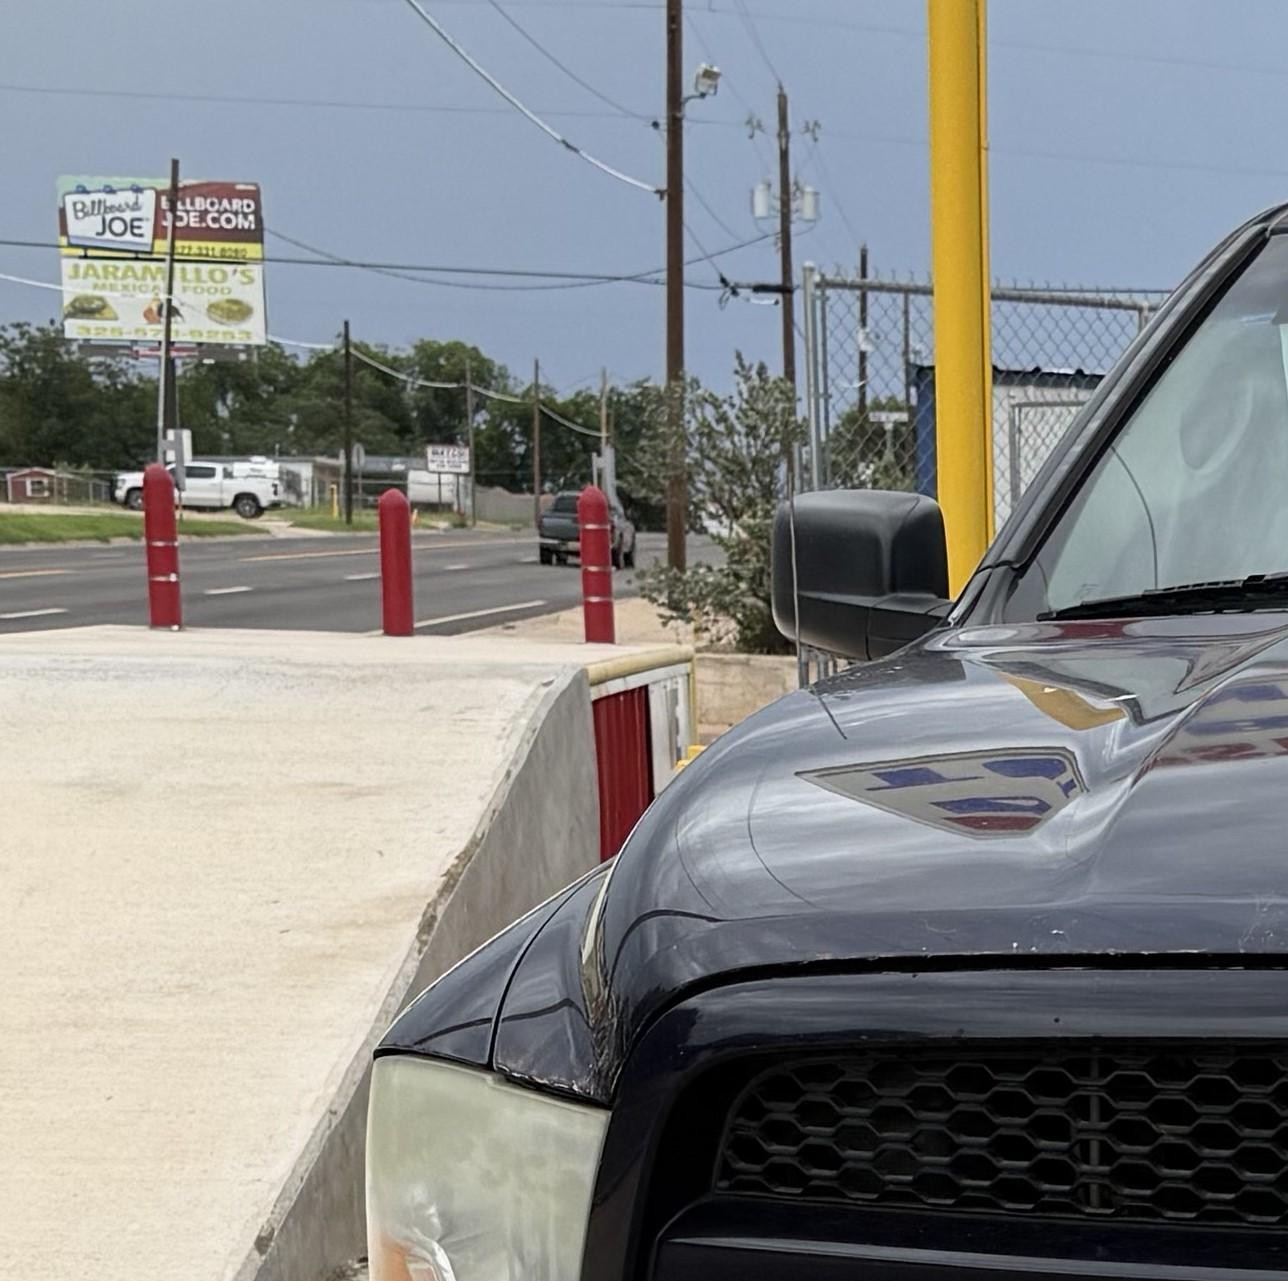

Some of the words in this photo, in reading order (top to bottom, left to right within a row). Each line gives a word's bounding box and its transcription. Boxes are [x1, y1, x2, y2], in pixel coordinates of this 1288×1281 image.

[72, 192, 142, 220] Billboard
[95, 216, 145, 238] JOE
[68, 263, 256, 285] JARAMLLO'S
[92, 282, 163, 294] MEXICA
[181, 286, 232, 296] FOOD
